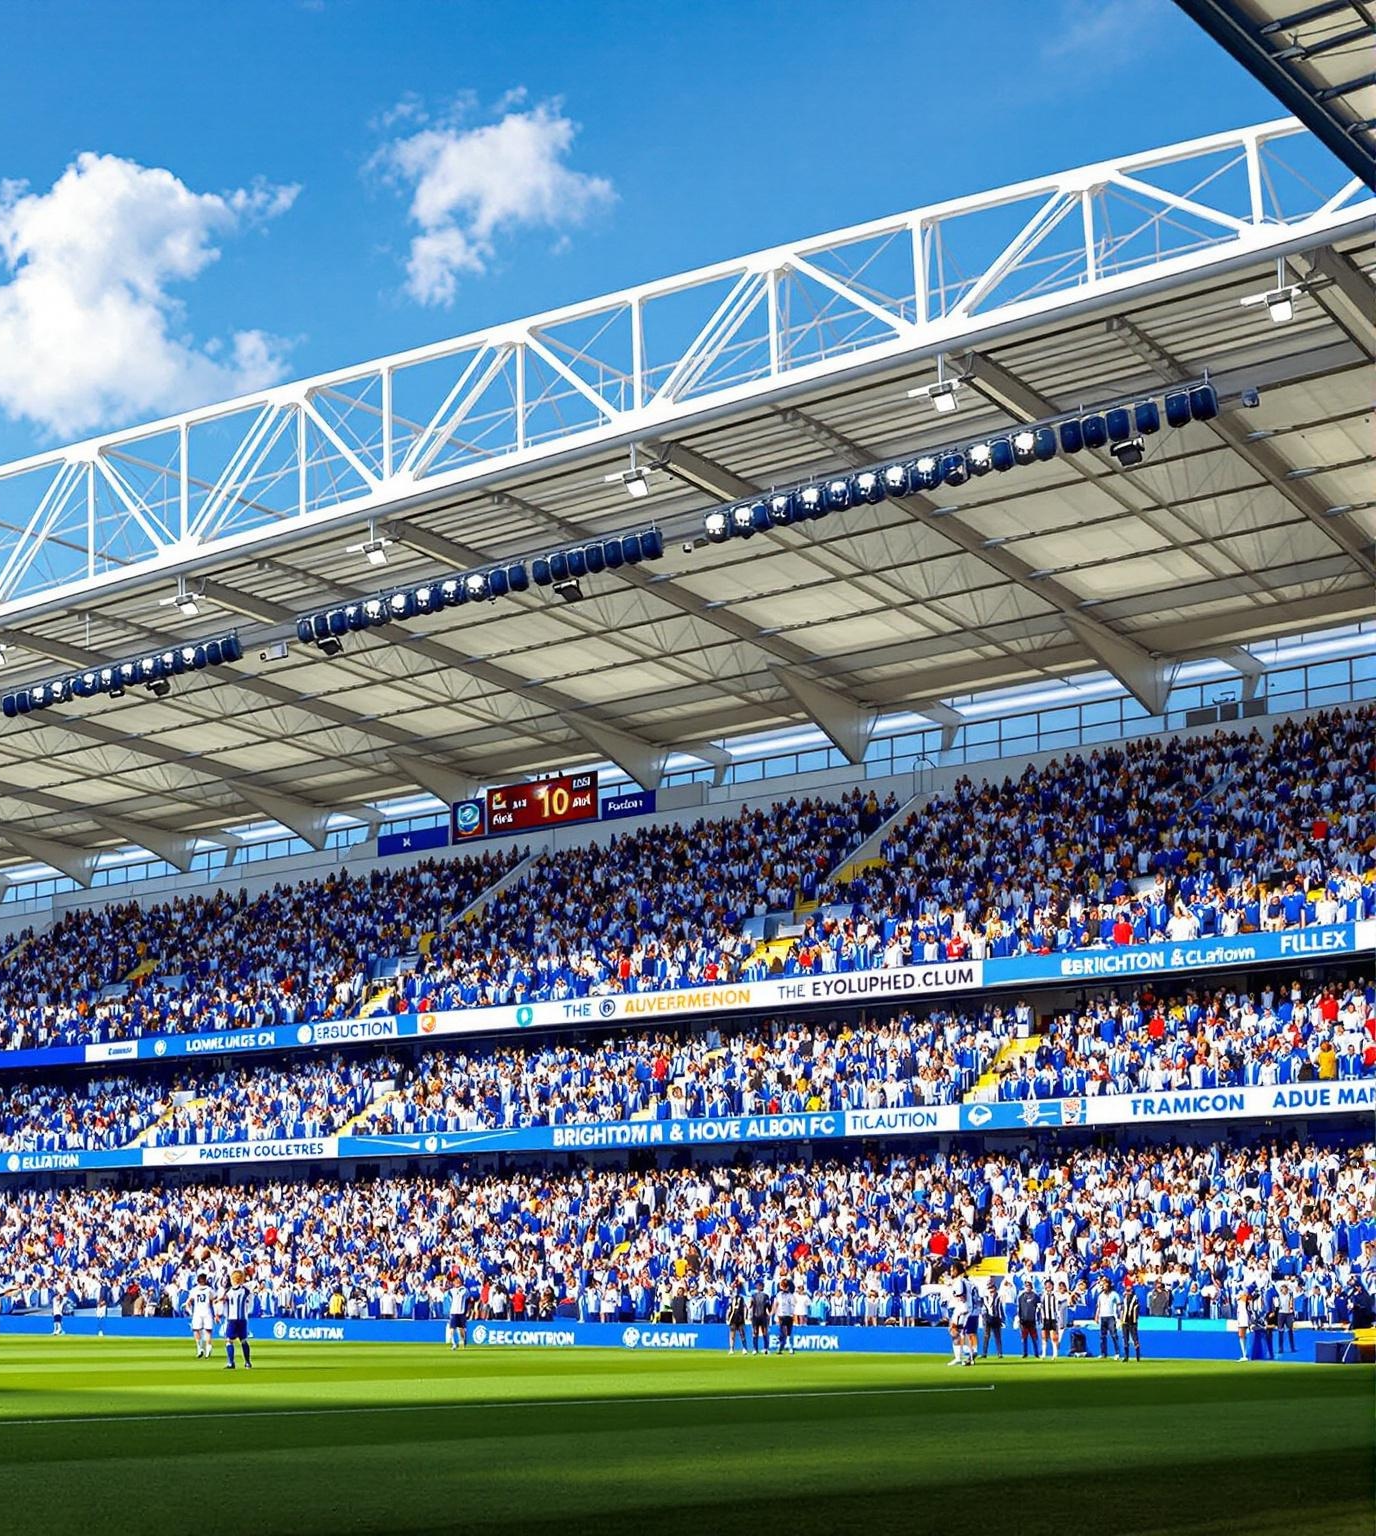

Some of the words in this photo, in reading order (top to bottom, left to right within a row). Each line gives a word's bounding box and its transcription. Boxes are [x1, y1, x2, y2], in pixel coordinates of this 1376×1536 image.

[563, 1002, 592, 1018] THE
[777, 984, 806, 999] THE
[1272, 1089, 1330, 1108] ADUE
[669, 1122, 684, 1141] &
[689, 1121, 741, 1140] HOVE
[746, 1117, 806, 1138] ALBON
[810, 1116, 835, 1135] FC
[641, 1332, 699, 1348] CASANT
